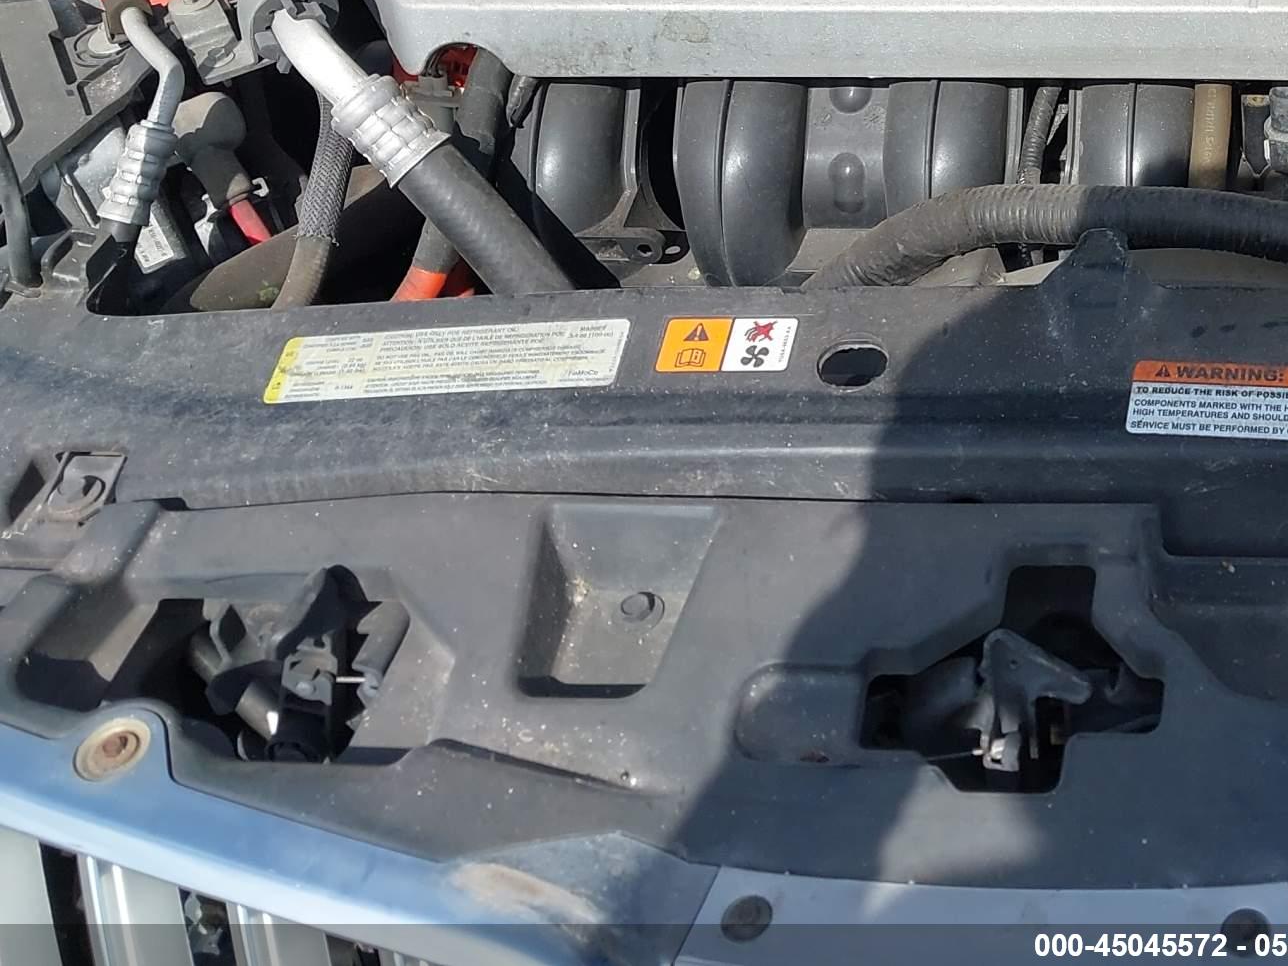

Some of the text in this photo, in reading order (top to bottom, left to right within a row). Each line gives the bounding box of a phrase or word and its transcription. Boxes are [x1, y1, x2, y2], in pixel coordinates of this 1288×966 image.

[1176, 365, 1284, 382] WARNING:
[1136, 385, 1149, 393] TO
[1151, 385, 1191, 395] REDUCE
[1192, 387, 1212, 396] THE
[1215, 389, 1238, 397] RISK
[1240, 390, 1255, 398] OF
[1134, 397, 1196, 408] COMPONENTS
[1198, 400, 1237, 410] MARKED
[1239, 402, 1261, 411] WITH
[1264, 404, 1281, 412] THE
[1132, 407, 1154, 415] HIGH
[1157, 408, 1228, 419] TEMPERATURES
[1230, 411, 1250, 420] AND
[1252, 412, 1288, 422] SHOULD
[1130, 419, 1169, 429] SERVICE
[1171, 421, 1196, 430] MUST
[1198, 423, 1211, 431] BE
[1213, 423, 1269, 434] PERFORMED
[1271, 426, 1284, 435] BY
